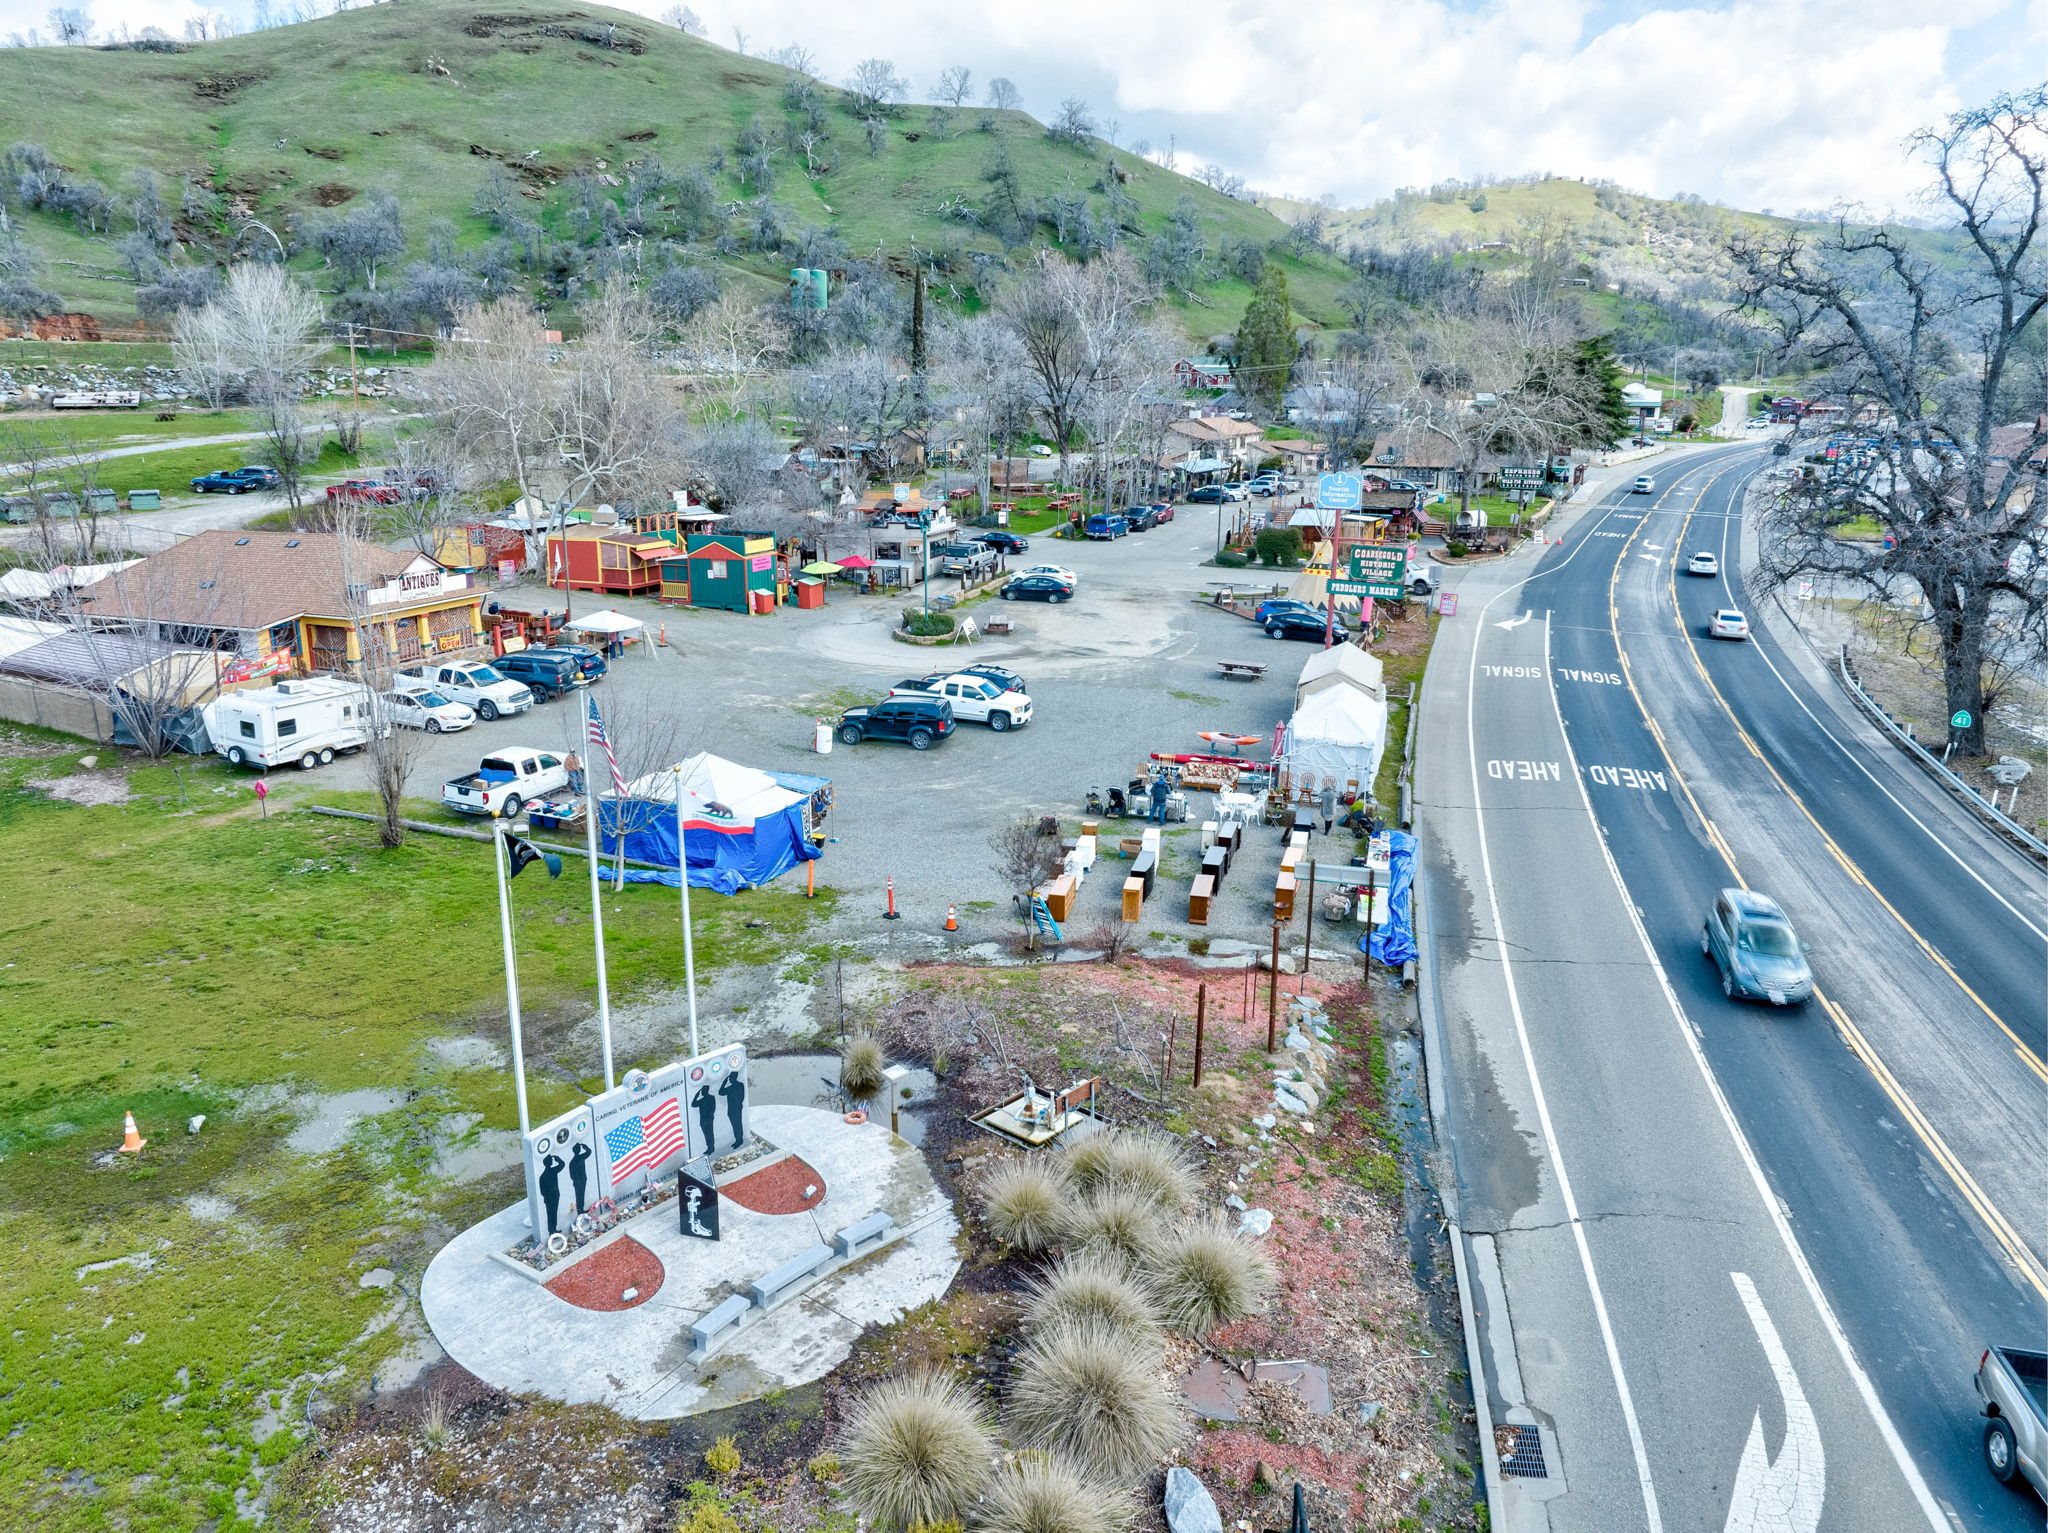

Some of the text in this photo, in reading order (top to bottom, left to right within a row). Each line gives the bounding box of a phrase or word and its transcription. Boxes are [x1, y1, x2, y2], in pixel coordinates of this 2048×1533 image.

[1593, 531, 1629, 539] AHEAD
[1354, 548, 1403, 562] COARSEGOLD
[1360, 560, 1396, 569] HISTORIC
[1361, 568, 1394, 578] VILLAGE
[401, 572, 440, 591] ANTIQUES
[1331, 582, 1399, 596] PEDDLERS MARKET
[441, 638, 460, 649] OPEN
[1480, 665, 1542, 678] SIGNAL
[1557, 668, 1622, 685] SIGNAL
[1955, 716, 1966, 725] 41
[1487, 759, 1561, 781] AHEAD
[1589, 765, 1668, 791] AHEAD
[595, 1080, 684, 1122] CARING VETERANS OF AMERICA
